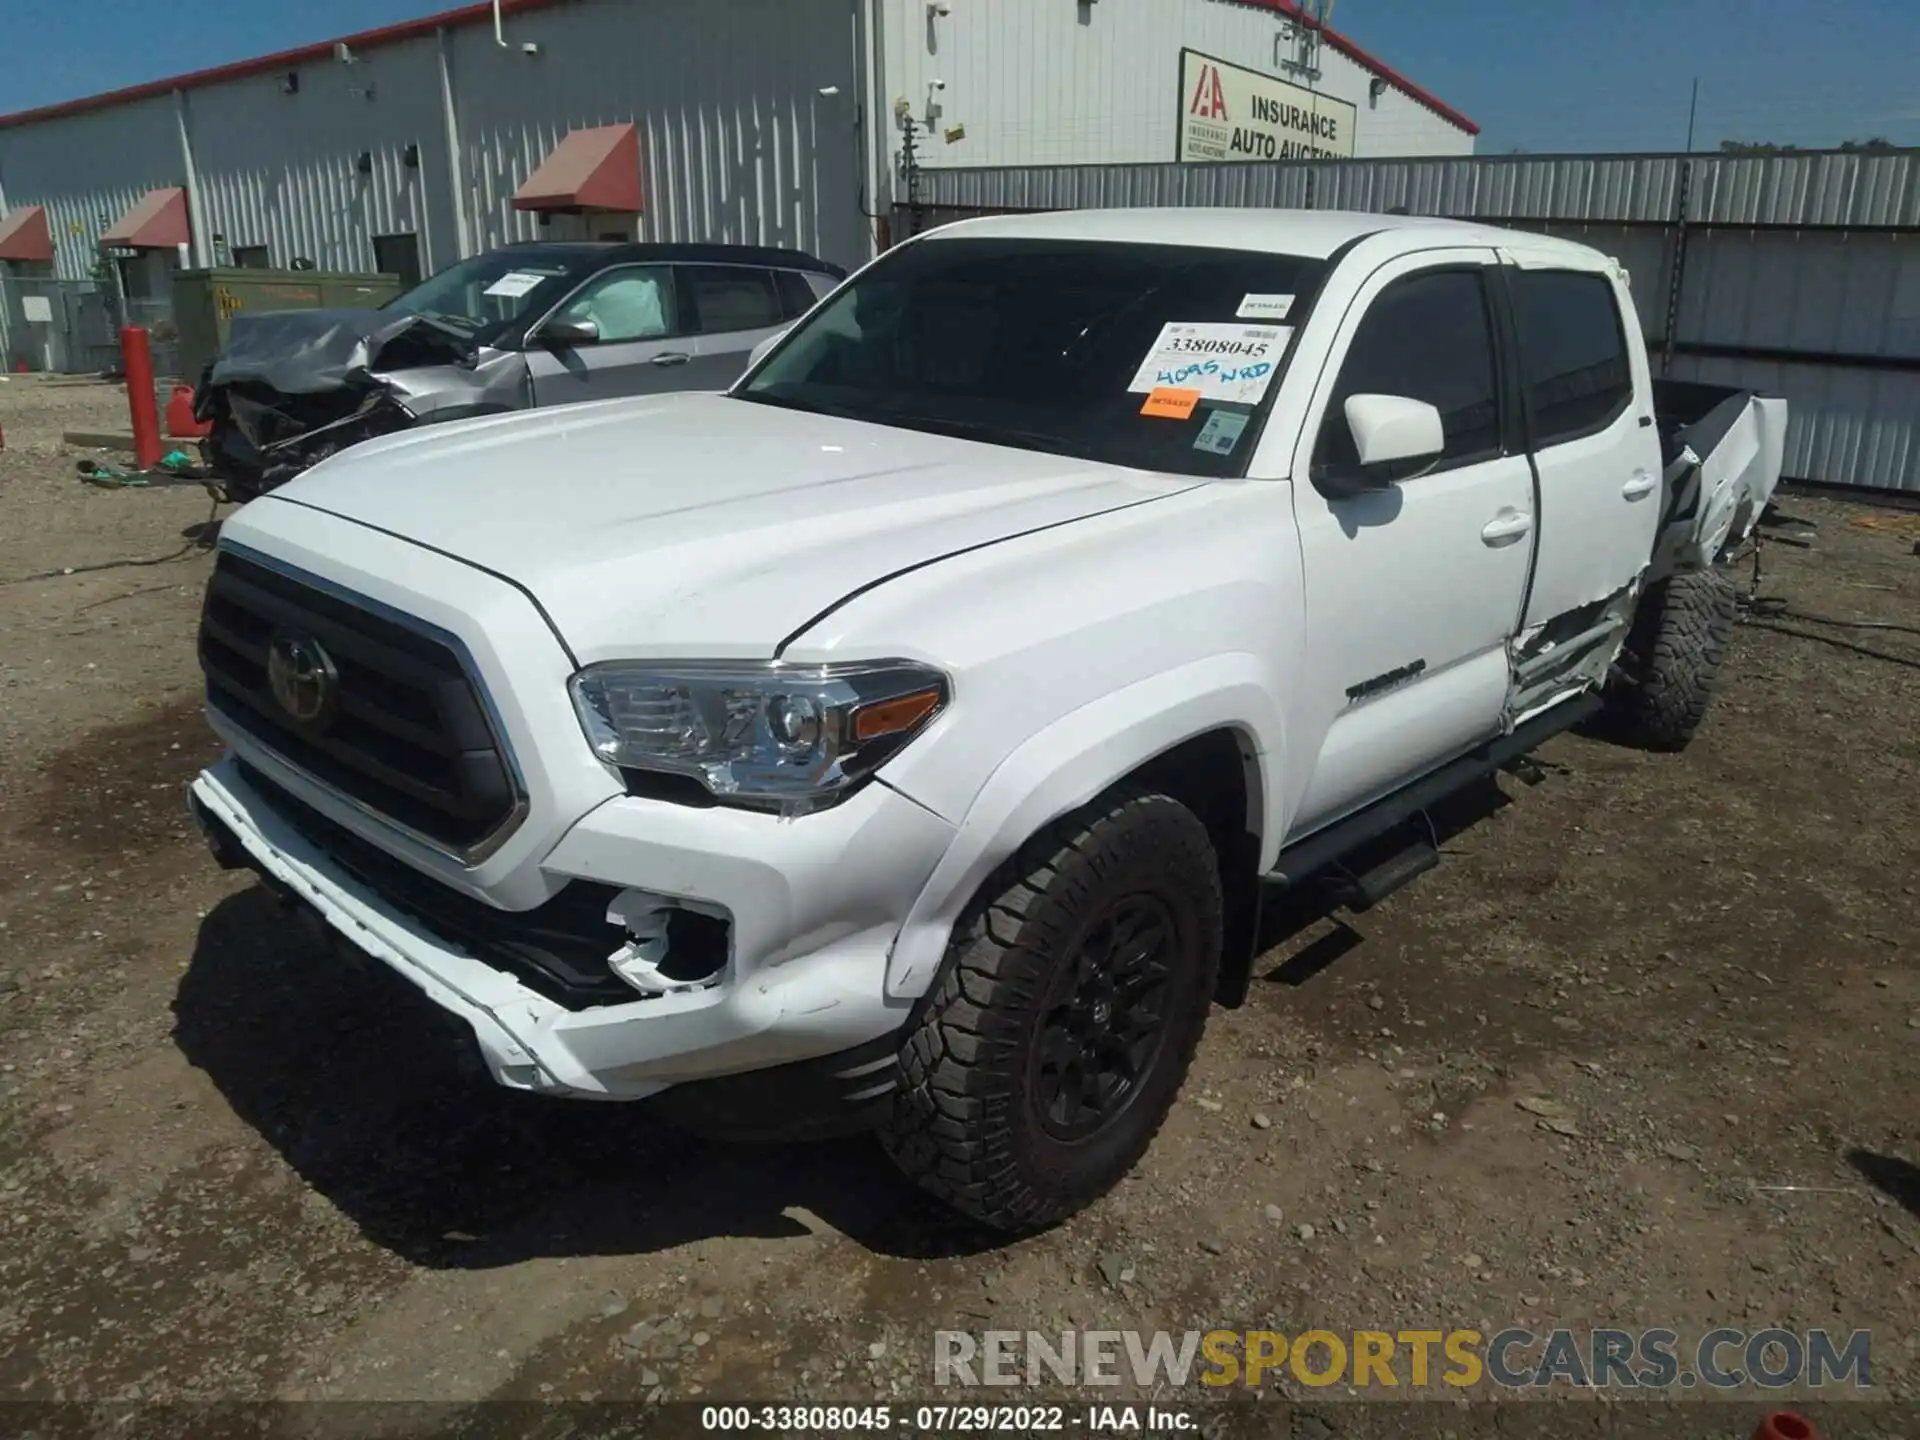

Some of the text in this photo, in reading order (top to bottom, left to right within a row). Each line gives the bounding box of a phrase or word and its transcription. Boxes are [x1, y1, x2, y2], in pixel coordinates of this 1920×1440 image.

[1252, 94, 1337, 141] INSURANCE
[1230, 127, 1276, 159] AUTO
[1166, 337, 1269, 358] 33808045
